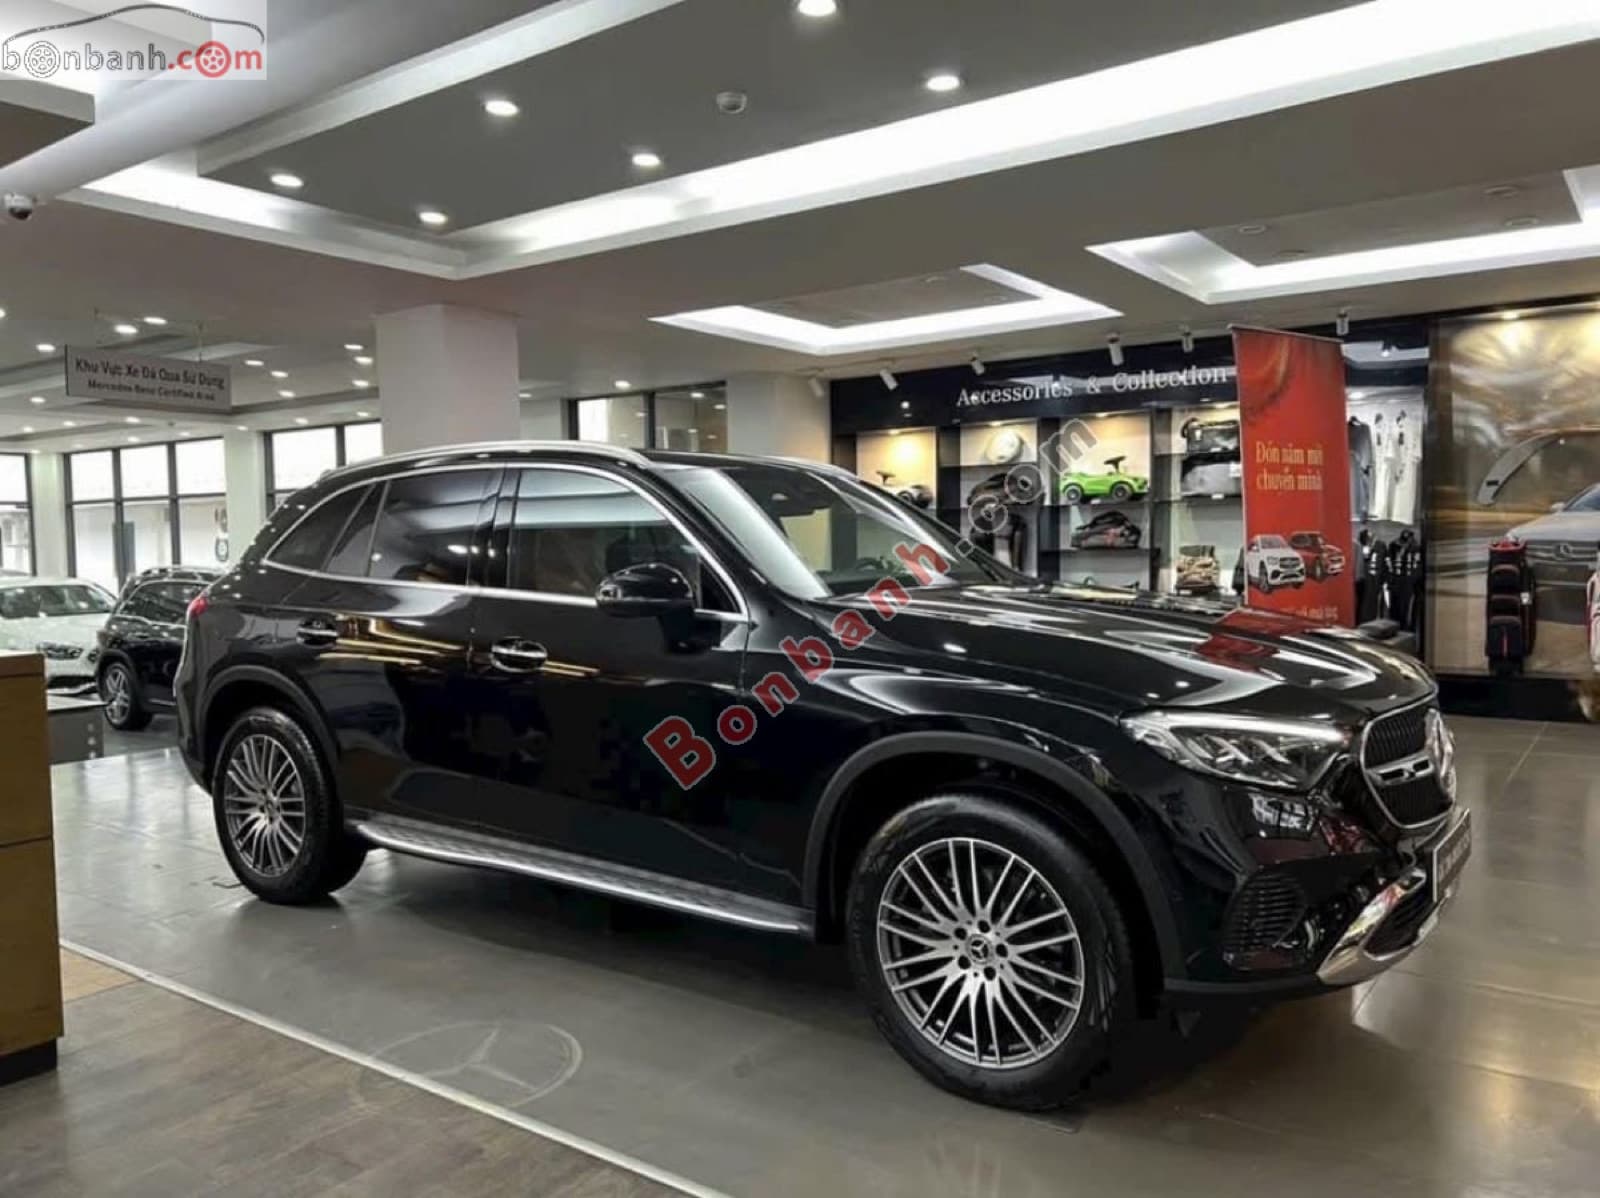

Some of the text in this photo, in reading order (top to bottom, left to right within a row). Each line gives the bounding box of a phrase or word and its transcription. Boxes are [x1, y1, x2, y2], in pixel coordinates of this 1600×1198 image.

[75, 358, 98, 373] Khu
[126, 364, 139, 377] Xe
[159, 368, 180, 382] Qua
[956, 365, 1228, 407] Accessories & Collection
